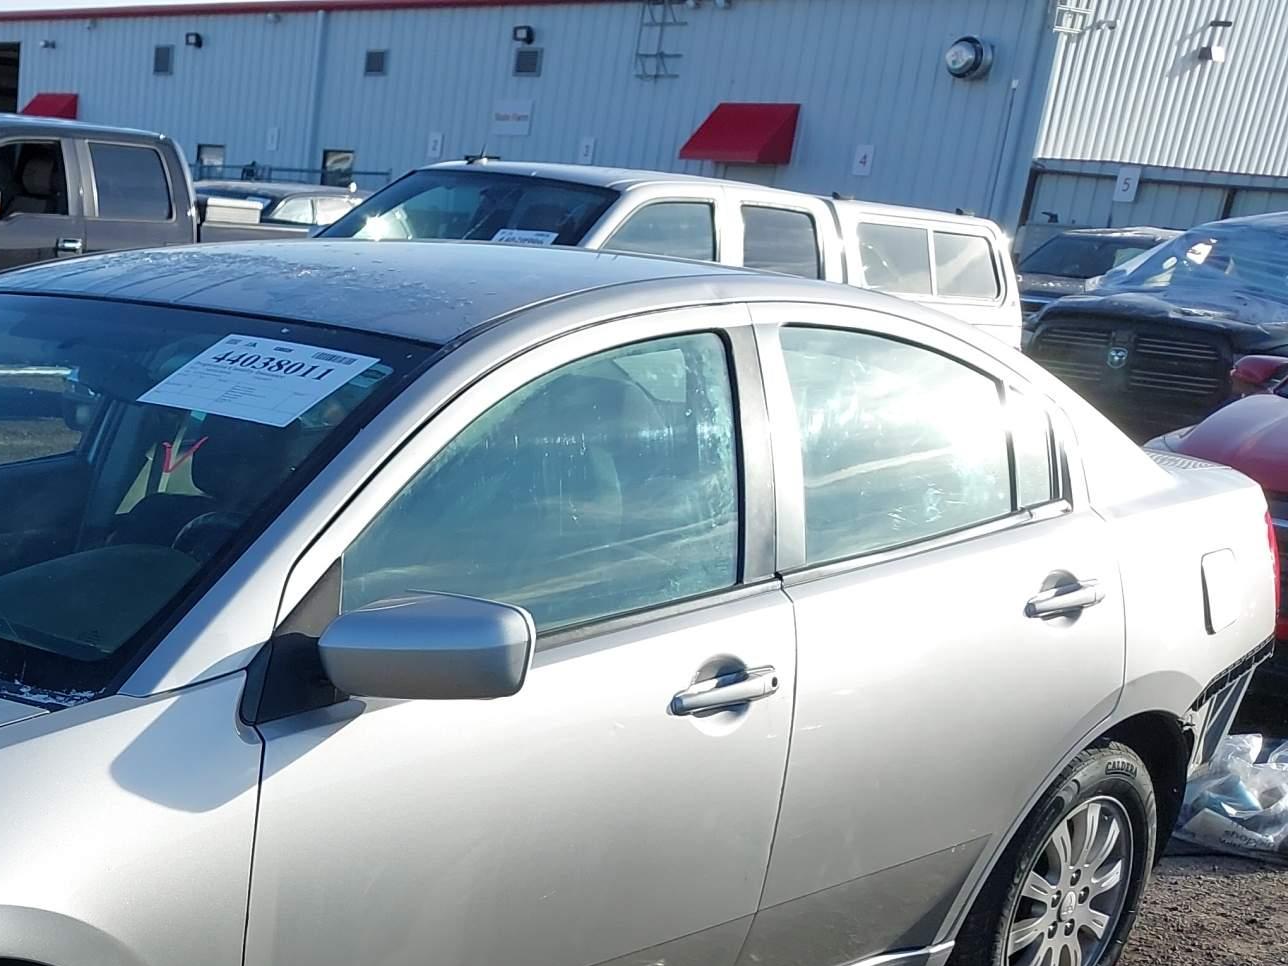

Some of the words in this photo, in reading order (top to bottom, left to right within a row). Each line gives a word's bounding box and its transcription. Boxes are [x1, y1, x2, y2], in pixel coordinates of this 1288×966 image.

[858, 152, 868, 168] 4
[1121, 177, 1132, 192] 5
[212, 350, 335, 381] 44038011
[1105, 760, 1138, 778] CALDERA
